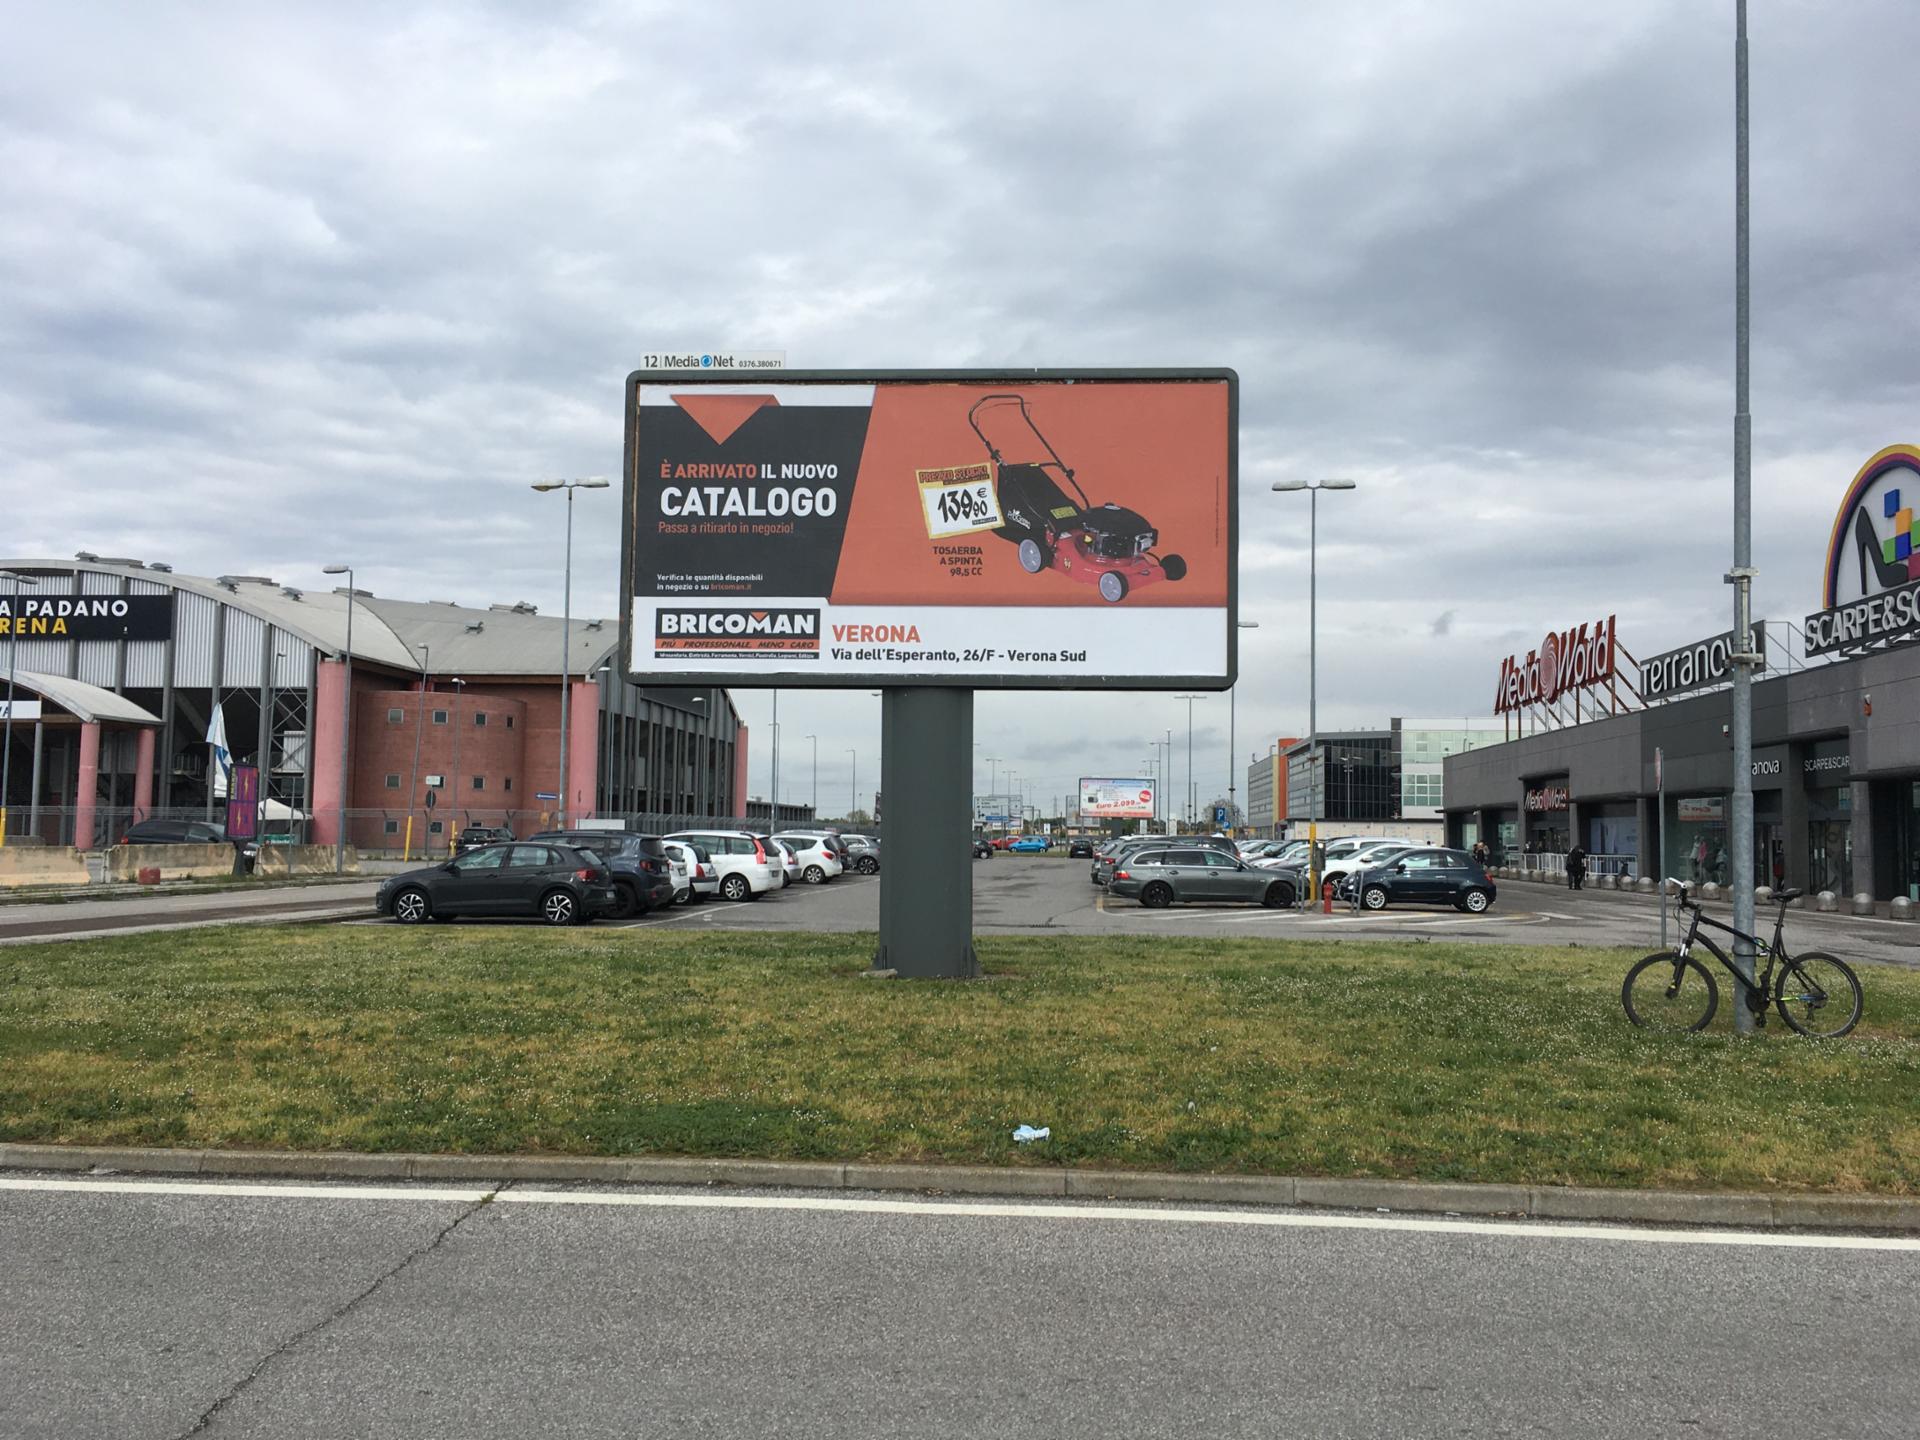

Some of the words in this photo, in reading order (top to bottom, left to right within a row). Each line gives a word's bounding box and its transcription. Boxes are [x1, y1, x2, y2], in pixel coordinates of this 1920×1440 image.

[644, 355, 658, 368] 12
[664, 355, 700, 368] Media
[713, 355, 735, 368] Net
[660, 459, 672, 479] È
[675, 463, 757, 479] ARRIVATO
[761, 464, 776, 479] IL
[781, 464, 838, 479] NUOVO
[660, 486, 837, 517] CATALOGO
[658, 521, 689, 534] Passa
[691, 524, 698, 534] a
[740, 522, 749, 534] in
[752, 522, 794, 536] negozio!
[933, 546, 983, 555] TOSAERBA
[940, 556, 947, 566] A
[949, 556, 983, 566] SPINTA
[971, 567, 983, 576] CC
[694, 574, 723, 582] quantità
[725, 574, 763, 583] disponibili
[665, 584, 693, 592] negozio
[26, 599, 129, 617] PADANO
[661, 612, 815, 634] BRICOMAN
[831, 625, 921, 643] VERONA
[758, 641, 785, 649] MENO
[790, 641, 815, 649] CARO
[831, 648, 853, 661] Via
[963, 650, 996, 662] 26/F
[1008, 650, 1058, 662] Verona
[1060, 650, 1087, 662] Sud
[1496, 652, 1541, 712] Media
[1556, 616, 1616, 692] World
[1218, 808, 1224, 820] P
